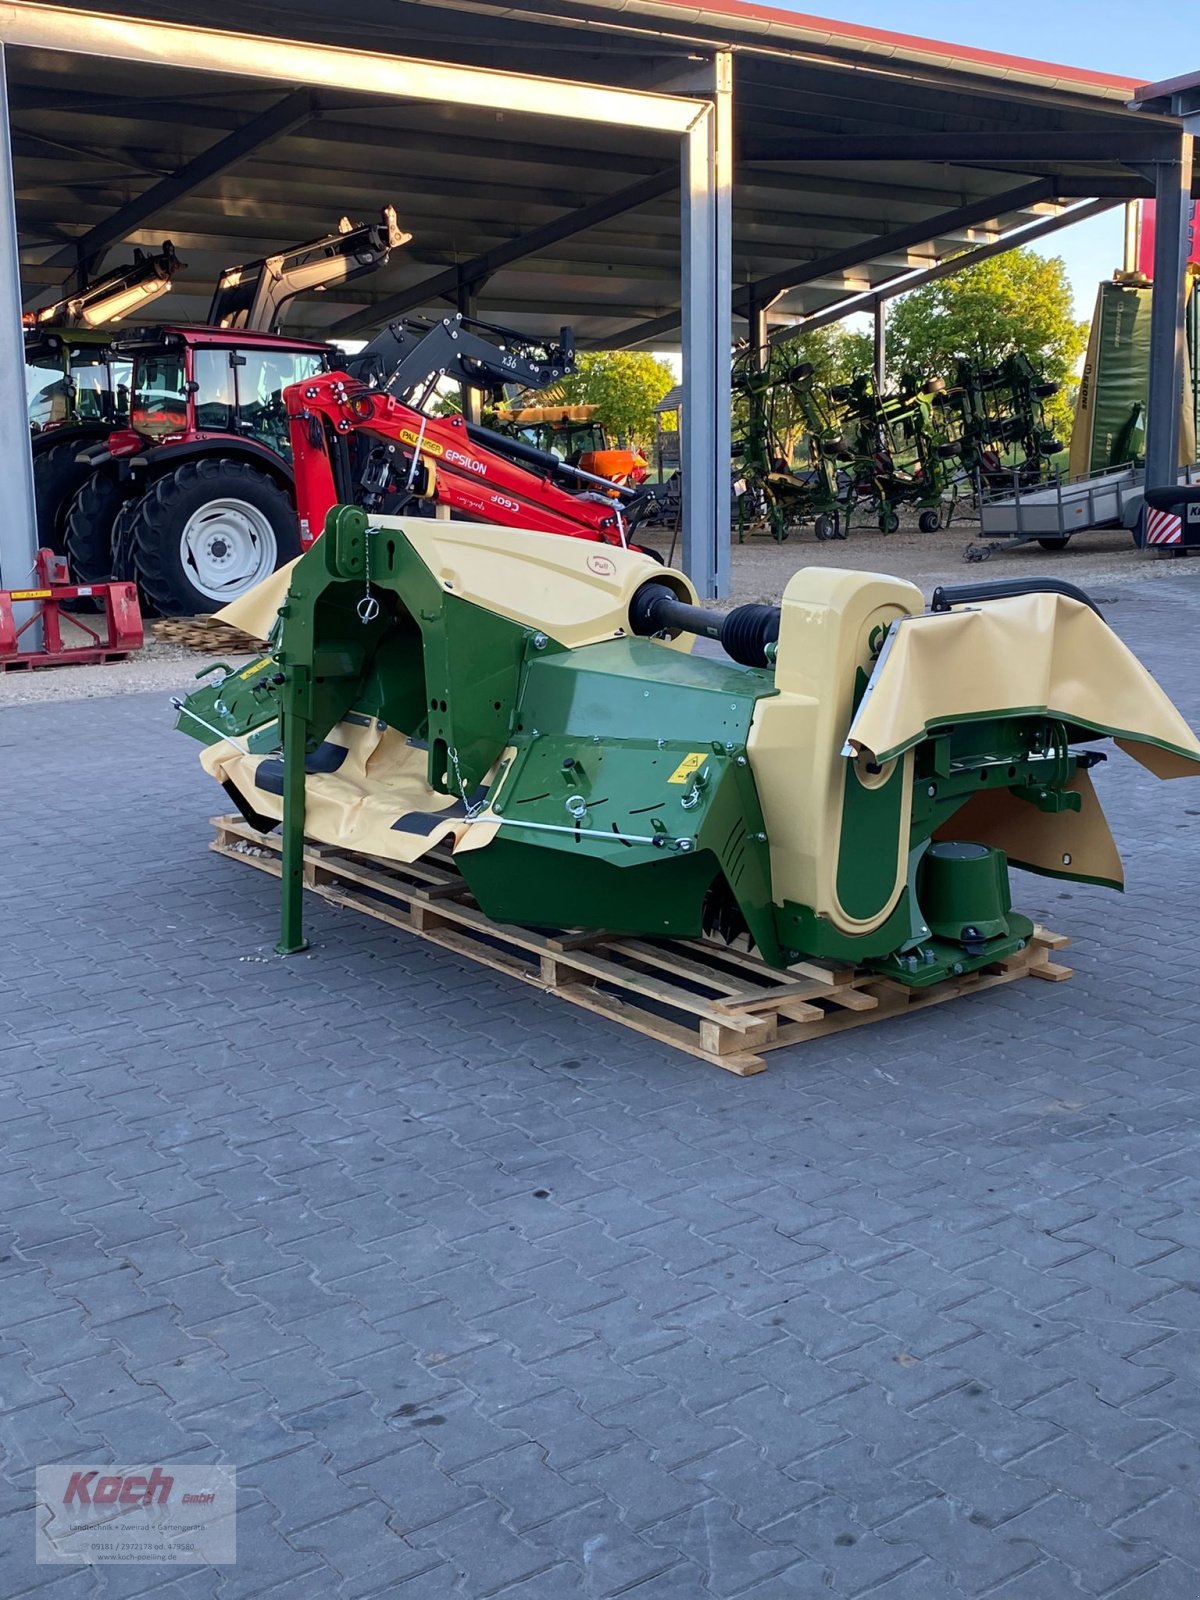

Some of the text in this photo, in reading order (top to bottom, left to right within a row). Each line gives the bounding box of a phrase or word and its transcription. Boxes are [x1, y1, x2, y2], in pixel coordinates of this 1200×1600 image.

[502, 355, 517, 369] x36
[1081, 375, 1090, 410] KRONE
[402, 430, 441, 453] PALNGER
[445, 449, 487, 475] EPSILON
[490, 495, 520, 512] C60F
[594, 561, 609, 570] Pull
